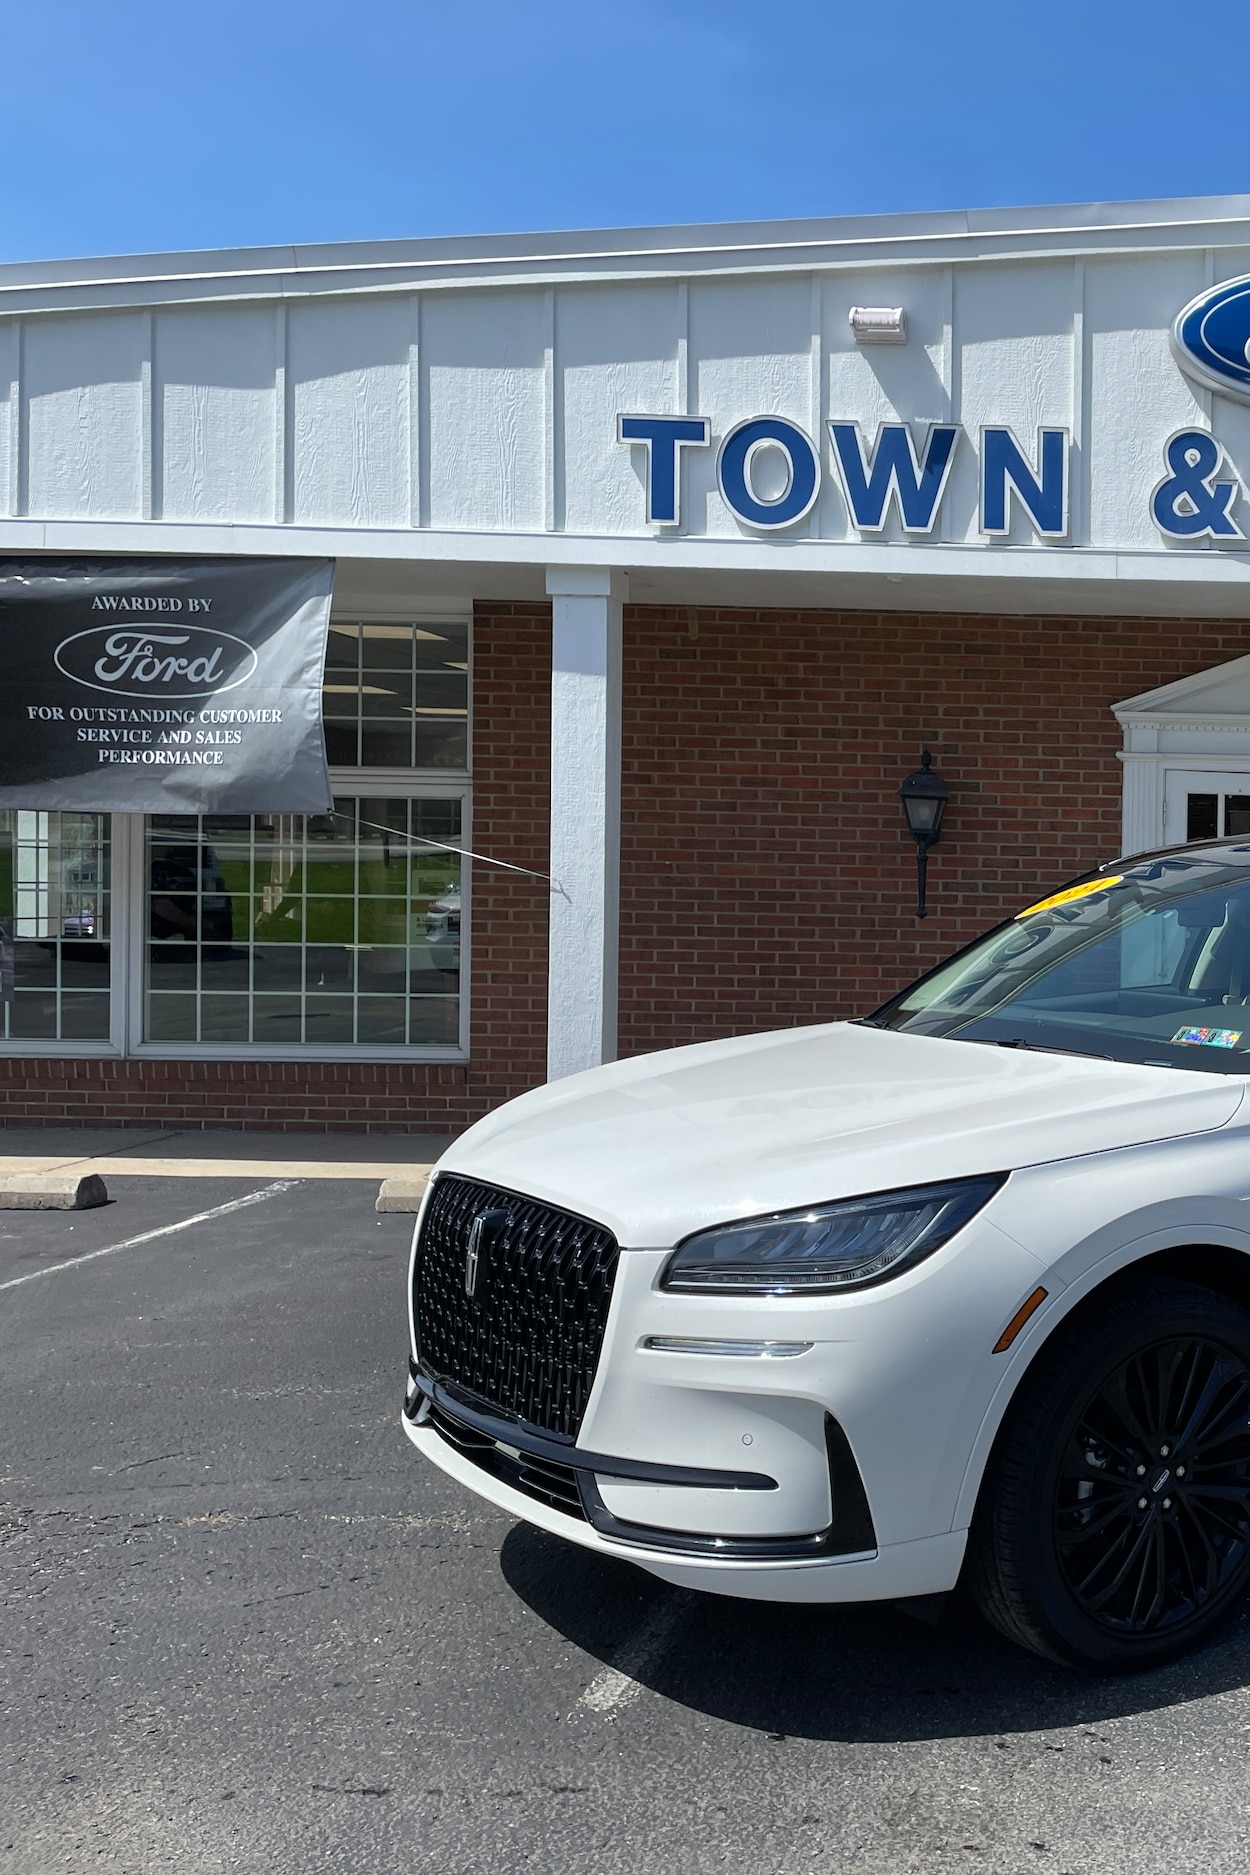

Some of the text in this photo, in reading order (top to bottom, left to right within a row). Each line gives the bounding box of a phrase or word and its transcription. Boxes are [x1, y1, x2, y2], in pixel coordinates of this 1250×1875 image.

[616, 413, 1072, 537] TOWN
[1149, 426, 1248, 541] &
[91, 596, 213, 613] AWARDED BY
[94, 632, 224, 684] Ford
[26, 706, 282, 724] FOR OUTSTANDING CUSTOMER
[77, 728, 242, 745] SERVICE AND SALES
[98, 750, 223, 765] PERFORMANCE
